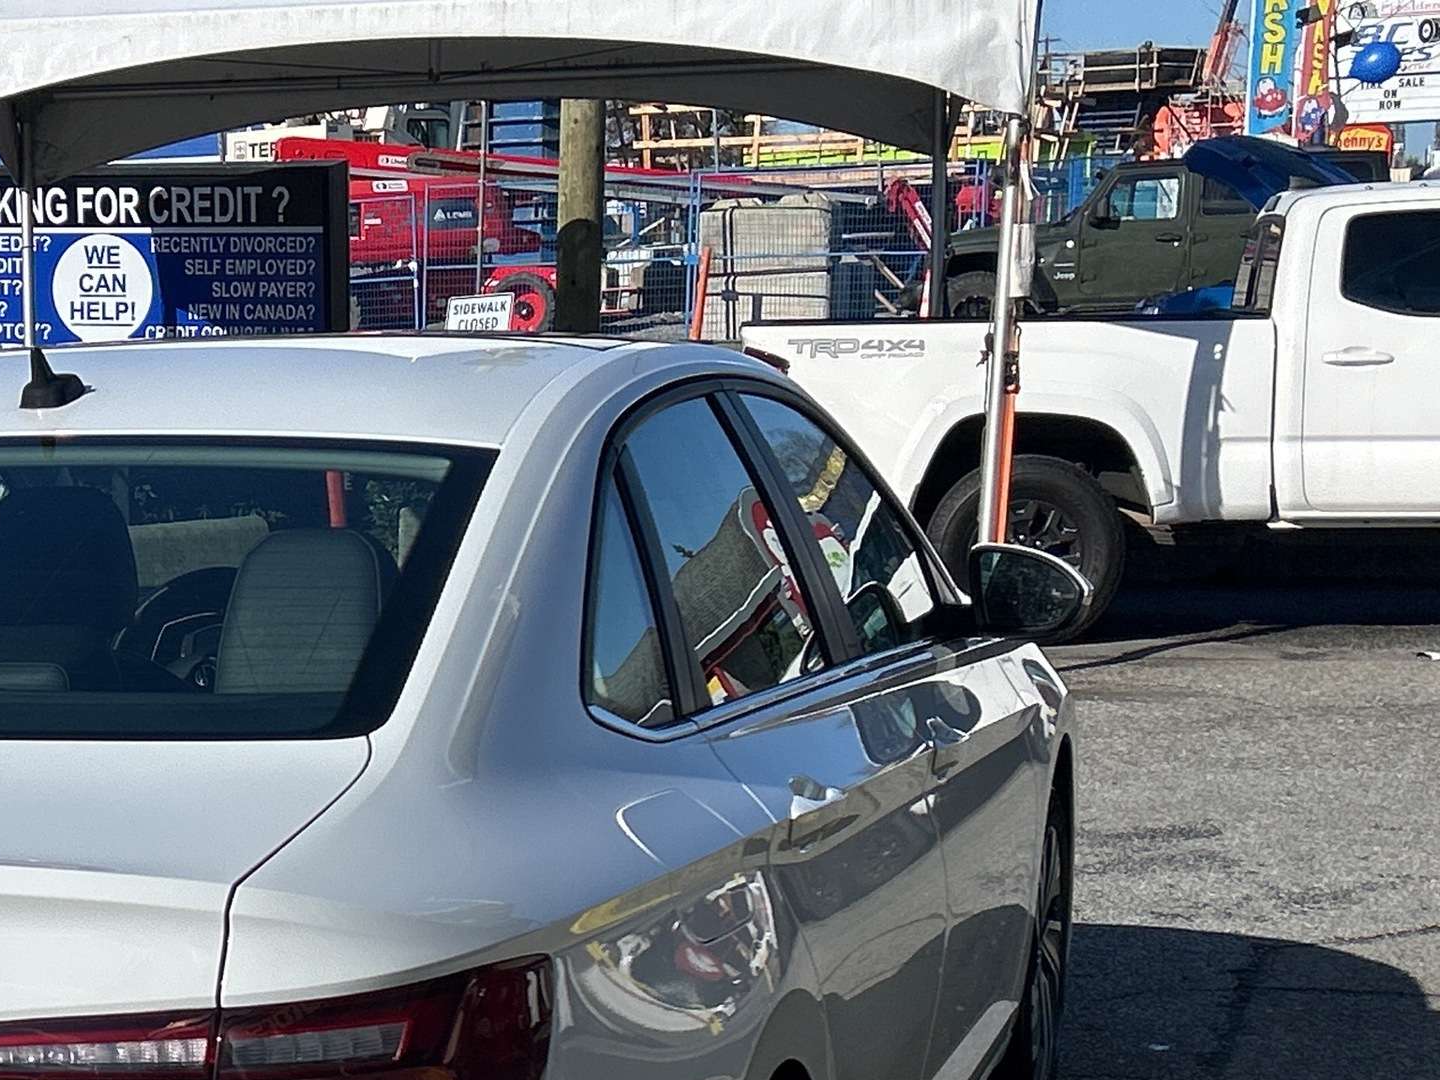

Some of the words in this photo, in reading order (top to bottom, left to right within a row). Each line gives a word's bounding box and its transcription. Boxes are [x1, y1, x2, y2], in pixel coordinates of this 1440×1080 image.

[1398, 77, 1425, 88] SALE
[1383, 89, 1397, 98] ON
[1337, 131, 1384, 150] enny's
[76, 187, 142, 224] FOR
[149, 186, 263, 224] CREDIT
[271, 186, 290, 222] ?
[151, 237, 226, 253] RECENTLY
[230, 237, 316, 253] DIVORCED?
[84, 245, 121, 265] WE
[184, 259, 221, 275] SELF
[226, 259, 316, 275] EMPLOYED?
[79, 273, 127, 293] CAN
[212, 282, 256, 298] SLOW
[260, 282, 316, 298] PAYER?
[70, 301, 136, 321] HELP!
[188, 304, 222, 320] NEW
[225, 304, 240, 320] IN
[245, 304, 316, 320] CANADA?
[453, 300, 507, 315] SIDEWALK
[145, 325, 198, 339] CREDIT
[458, 317, 499, 331] CLOSED
[788, 338, 859, 359] TRD
